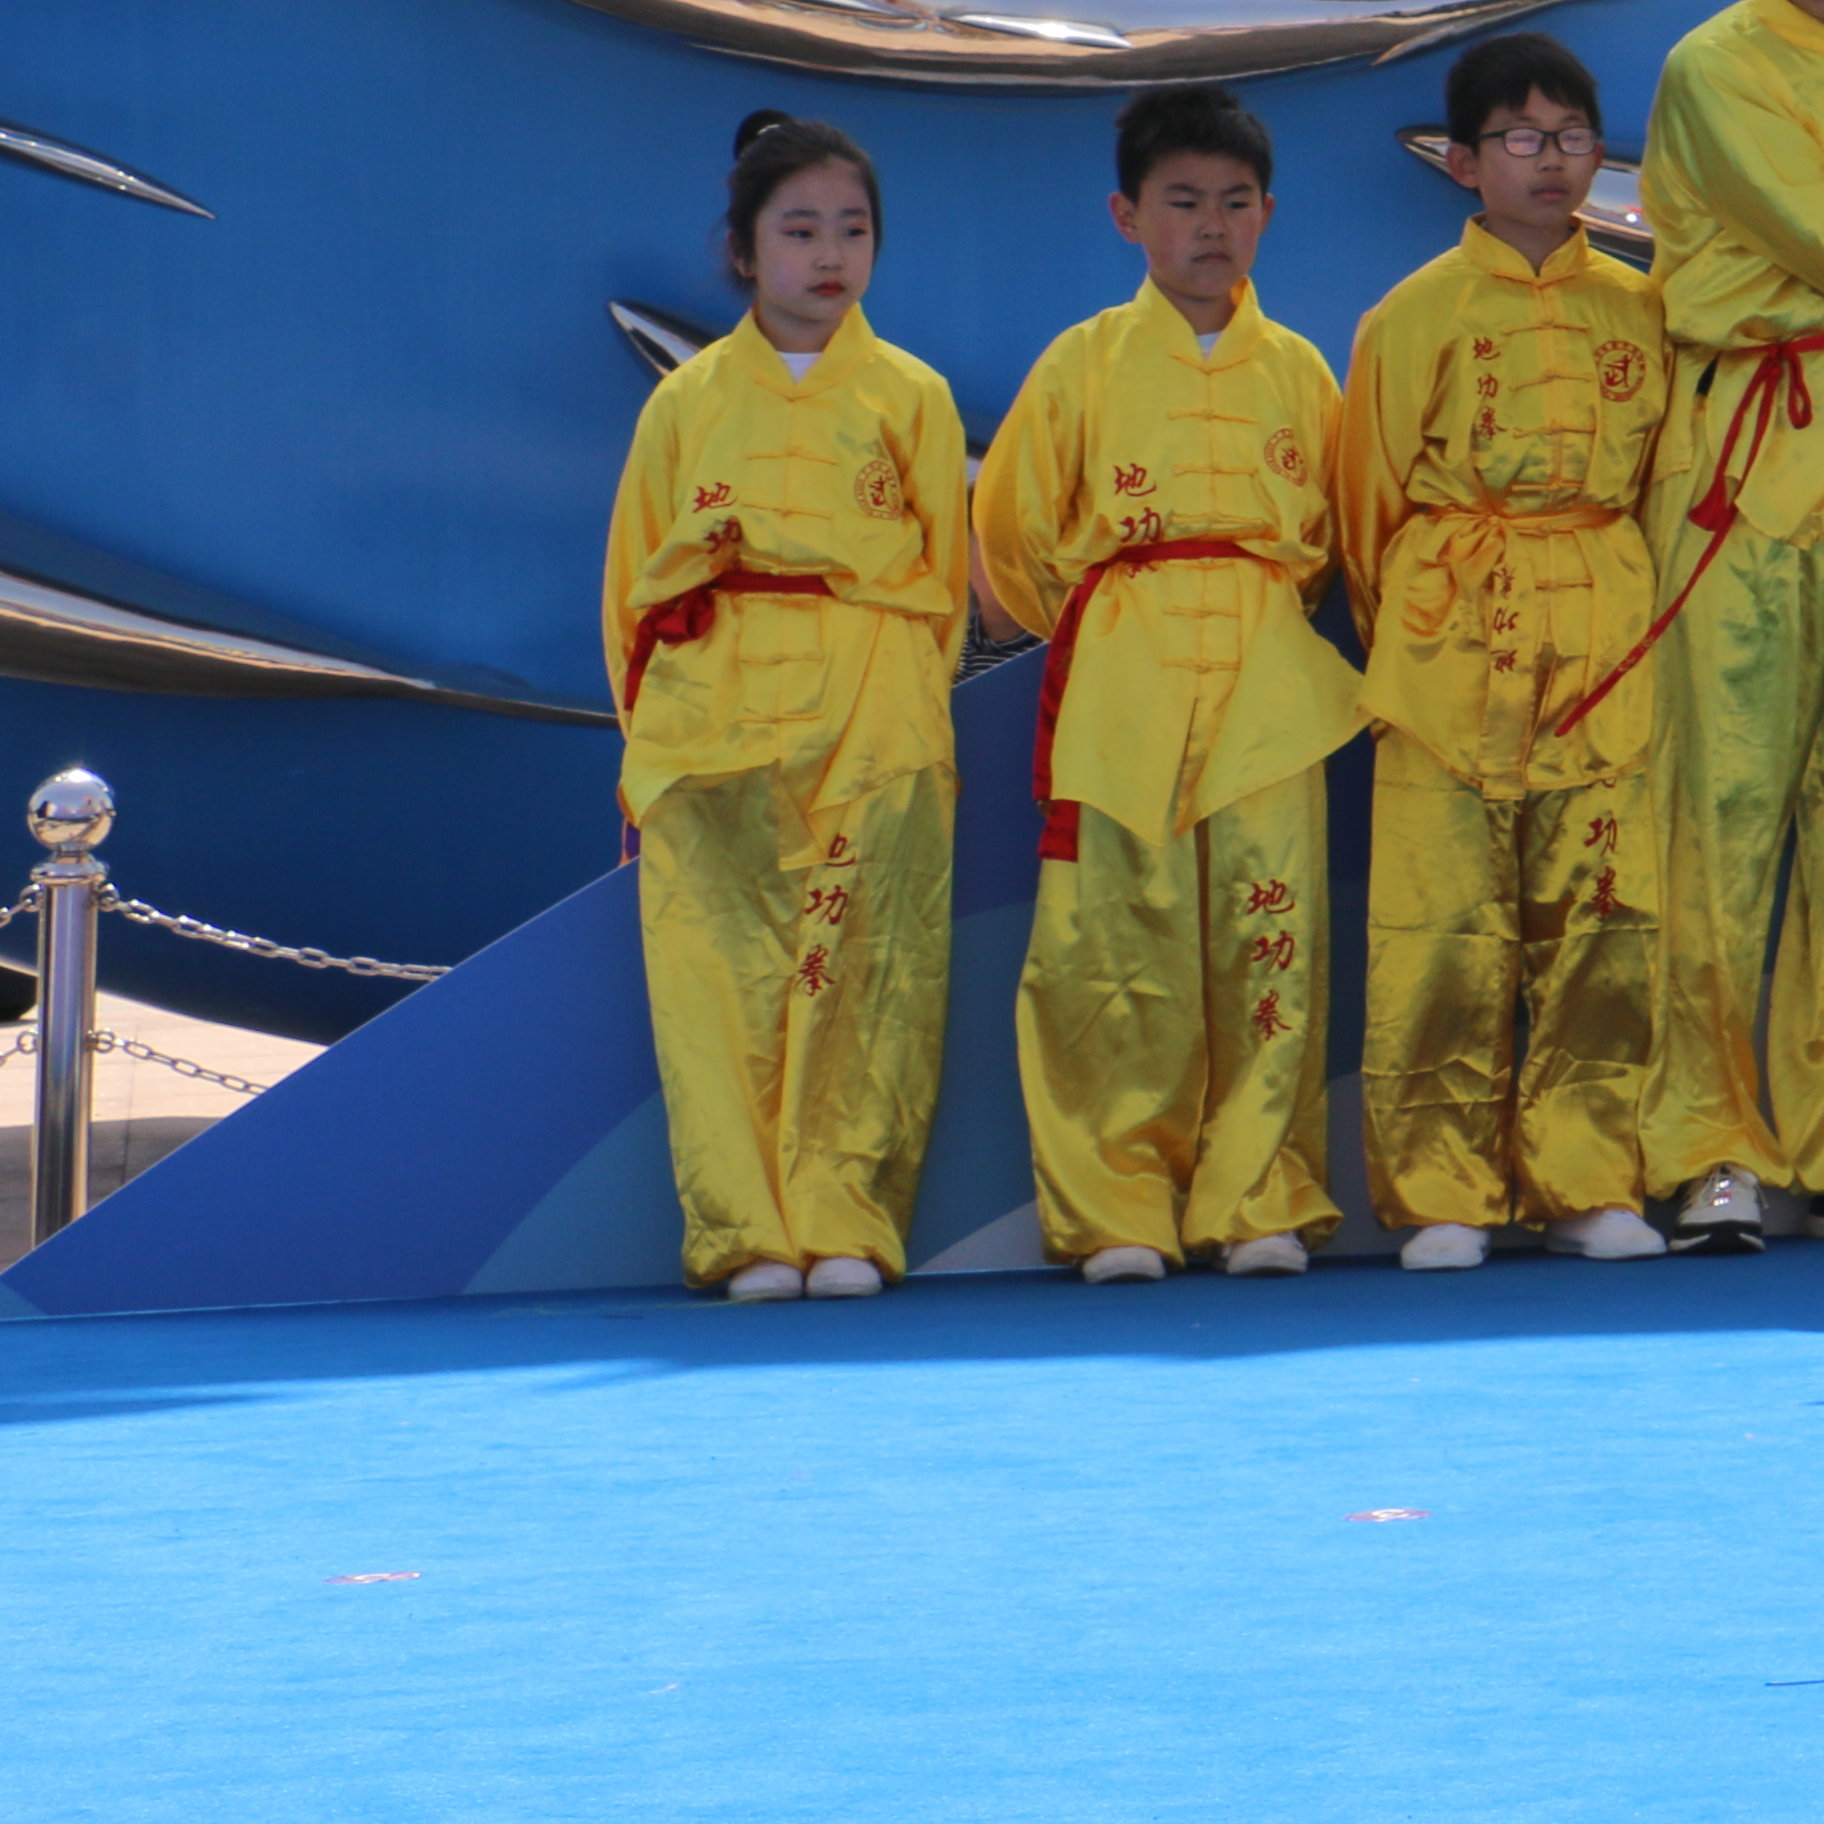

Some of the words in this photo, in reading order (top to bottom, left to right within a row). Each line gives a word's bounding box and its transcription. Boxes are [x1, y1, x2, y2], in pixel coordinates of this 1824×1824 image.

[1472, 336, 1507, 441] 地功拳
[1582, 778, 1628, 922] 功拳
[1247, 878, 1296, 1042] 地功拳
